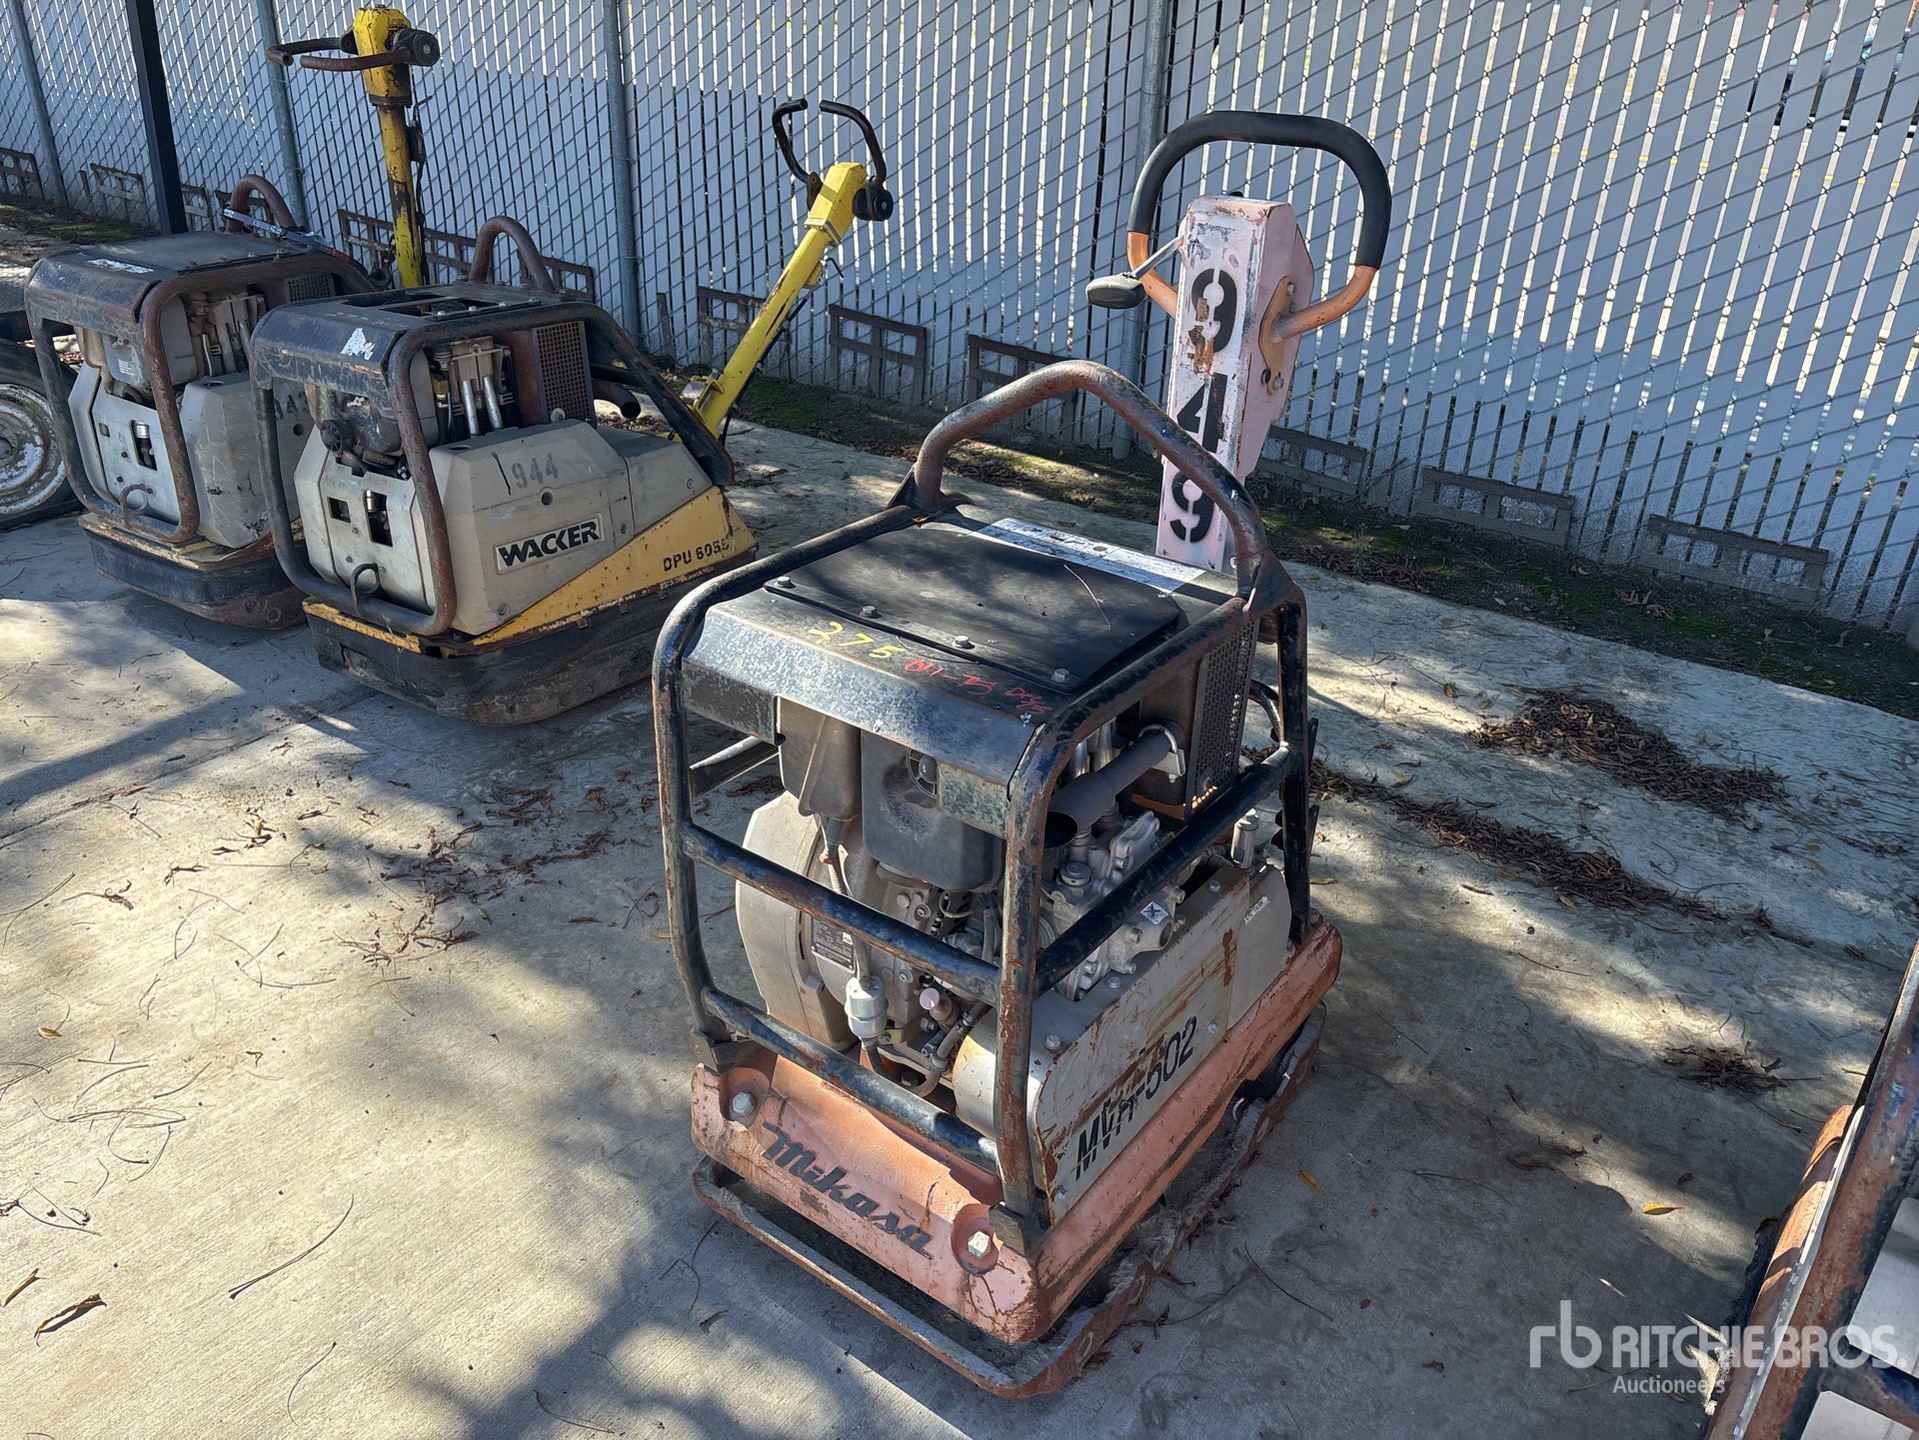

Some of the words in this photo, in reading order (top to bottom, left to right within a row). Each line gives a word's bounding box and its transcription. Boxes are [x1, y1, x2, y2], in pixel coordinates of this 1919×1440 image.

[498, 521, 600, 567] WACKER
[663, 549, 692, 572] DPU
[807, 621, 904, 659] 275
